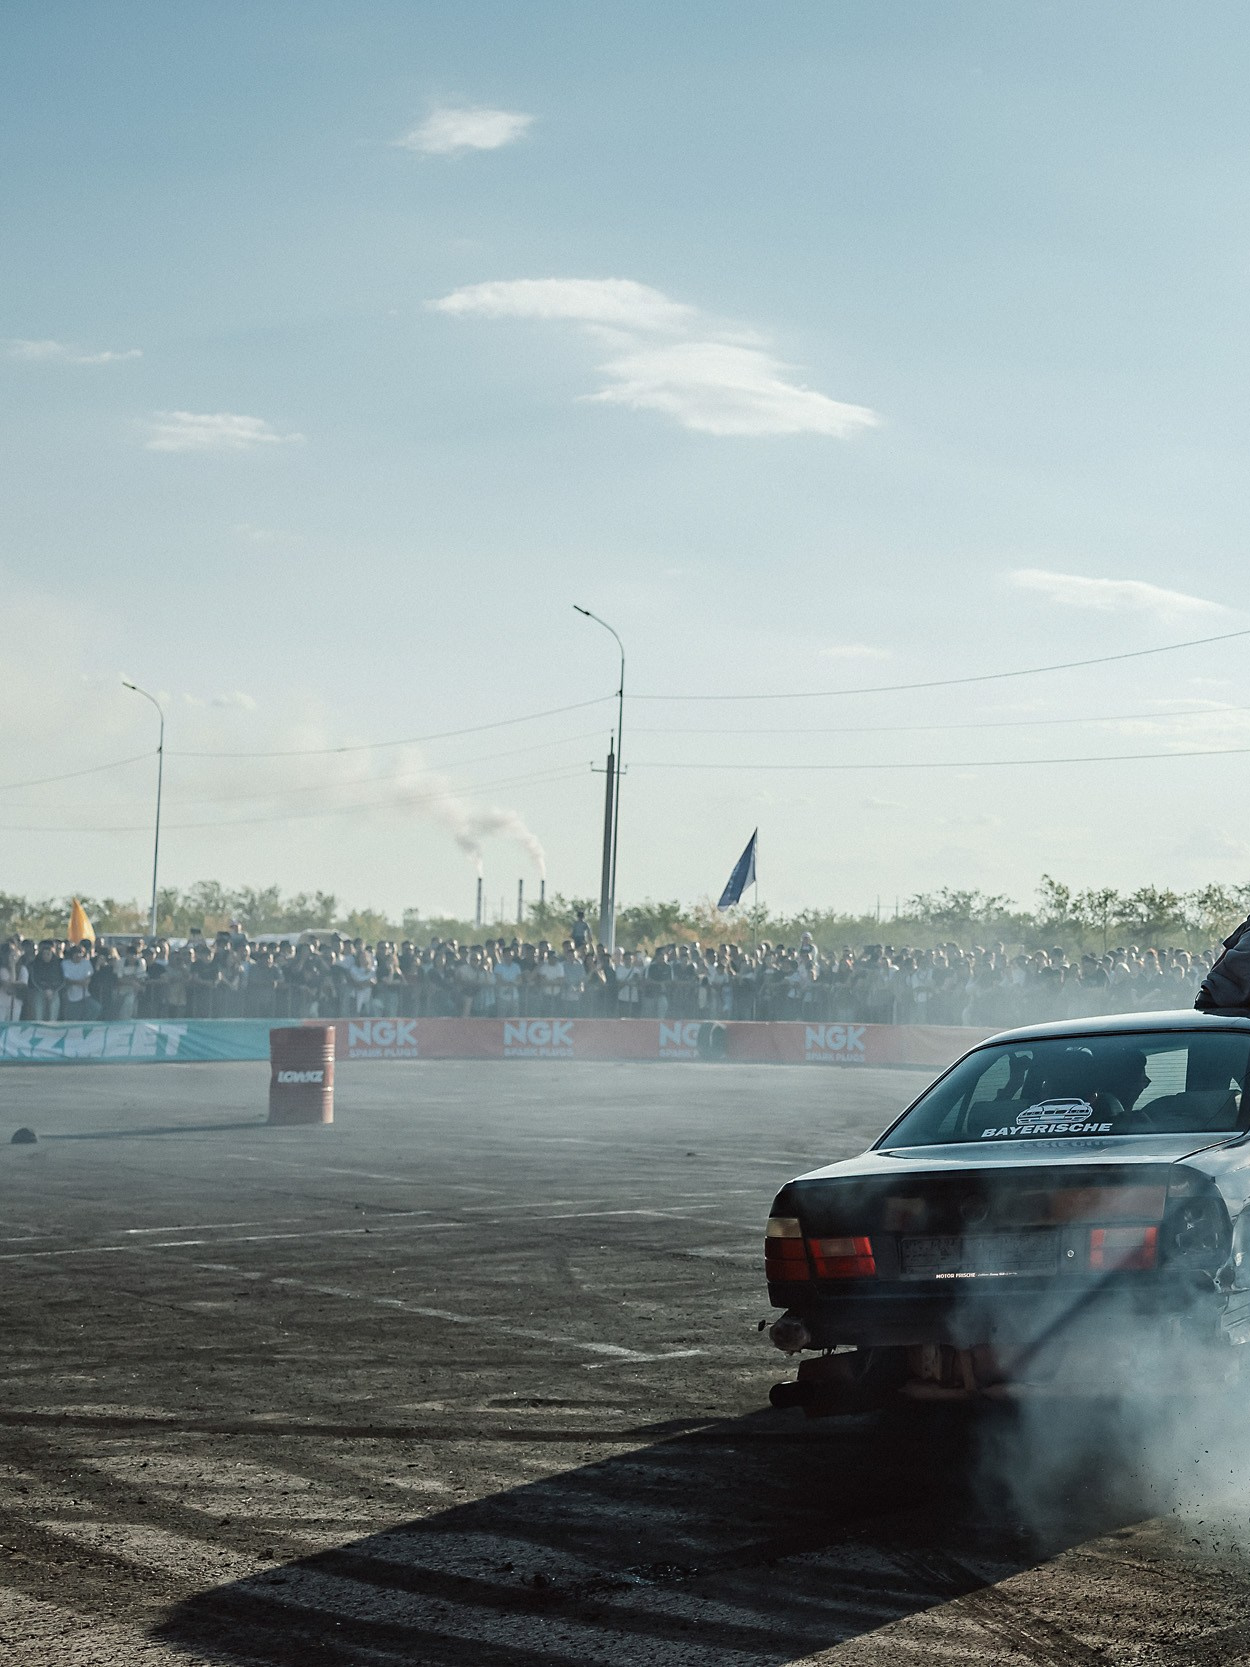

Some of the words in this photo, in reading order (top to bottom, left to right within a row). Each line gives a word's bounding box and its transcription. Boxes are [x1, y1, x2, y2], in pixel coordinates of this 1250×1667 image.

[348, 1020, 418, 1046] NGK
[503, 1020, 575, 1046] NGK
[659, 1021, 700, 1047] NG
[804, 1025, 866, 1050] NGK
[981, 1122, 1113, 1138] BAYERISCHE
